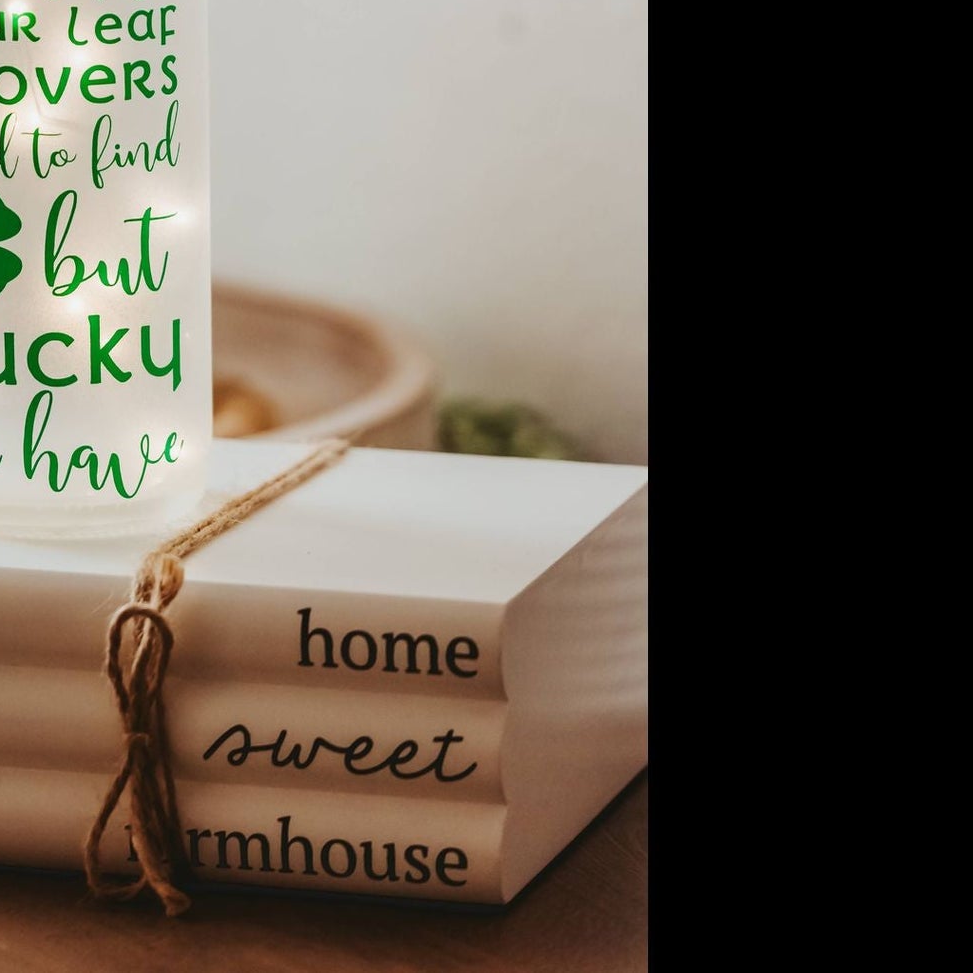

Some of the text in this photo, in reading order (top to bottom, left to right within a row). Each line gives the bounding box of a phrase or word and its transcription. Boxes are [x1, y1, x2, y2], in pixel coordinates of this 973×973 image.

[21, 127, 78, 179] to
[91, 100, 181, 190] find
[44, 189, 178, 297] but
[23, 389, 184, 499] have
[296, 607, 481, 679] home
[203, 724, 478, 784] sweet
[124, 815, 469, 887] rmhouse
